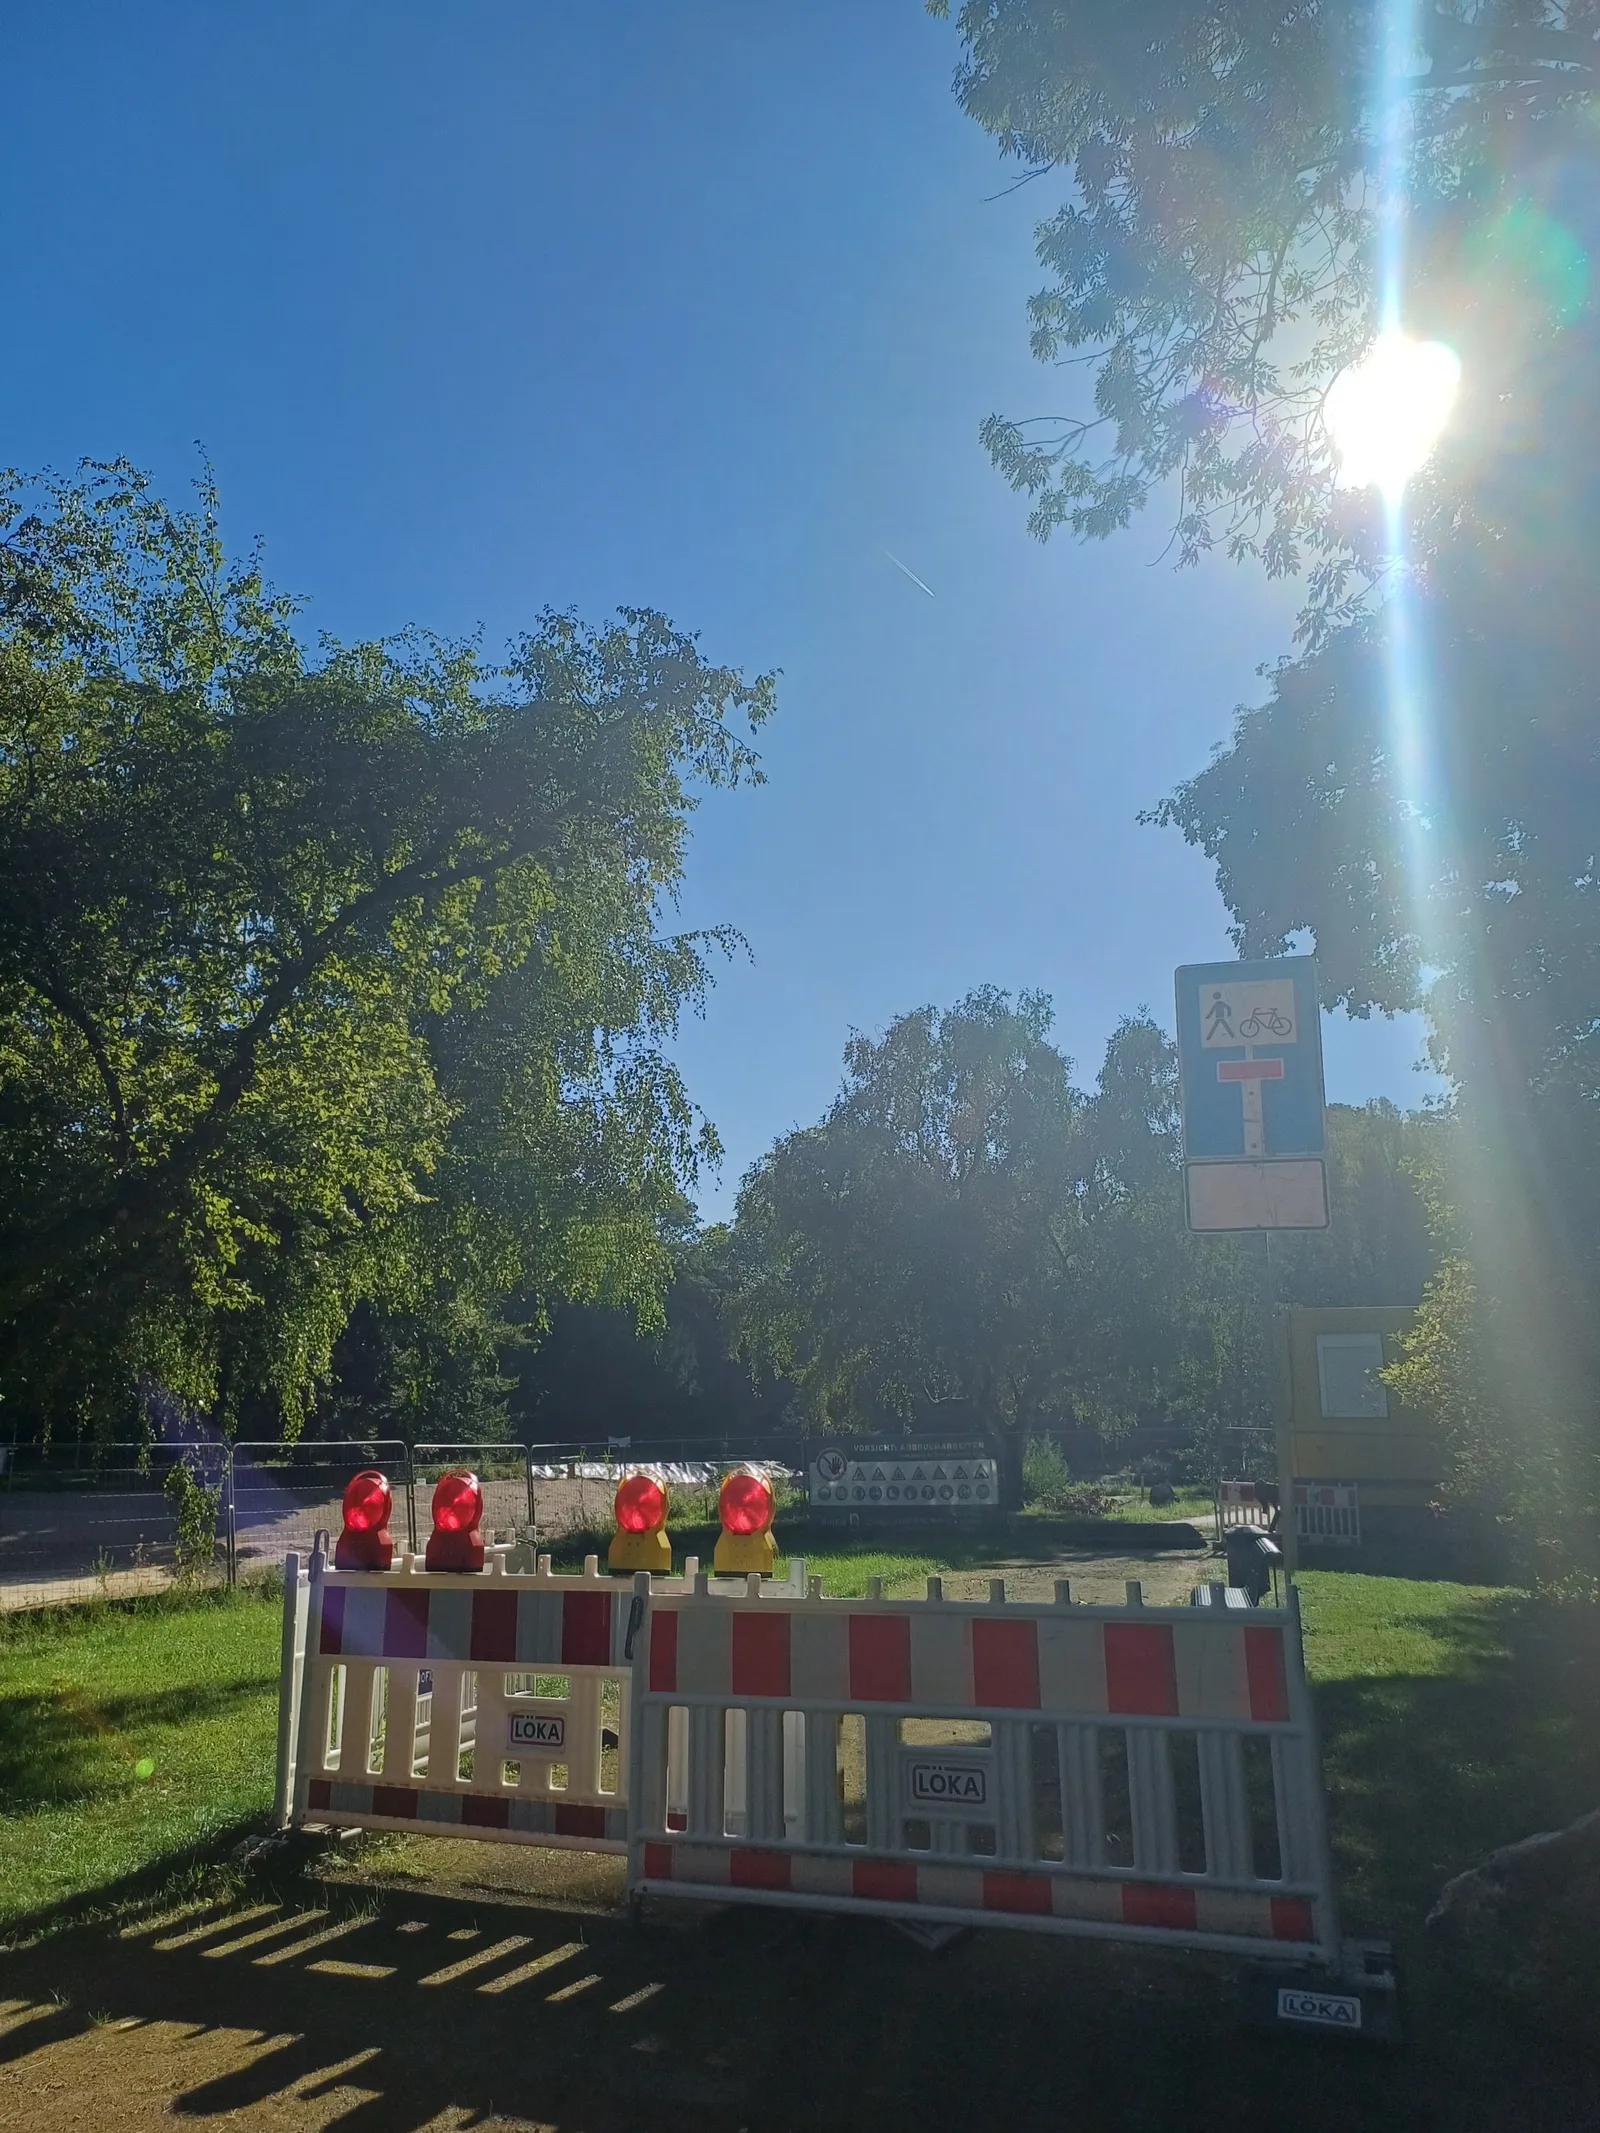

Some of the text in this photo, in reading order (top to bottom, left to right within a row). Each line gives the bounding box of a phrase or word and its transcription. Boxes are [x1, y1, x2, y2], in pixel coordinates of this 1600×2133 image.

[853, 1443, 898, 1452] VORSICHT:
[515, 1714, 560, 1741] LÖKA
[918, 1765, 980, 1797] LÖKA
[1287, 1995, 1351, 2020] LÖKA
